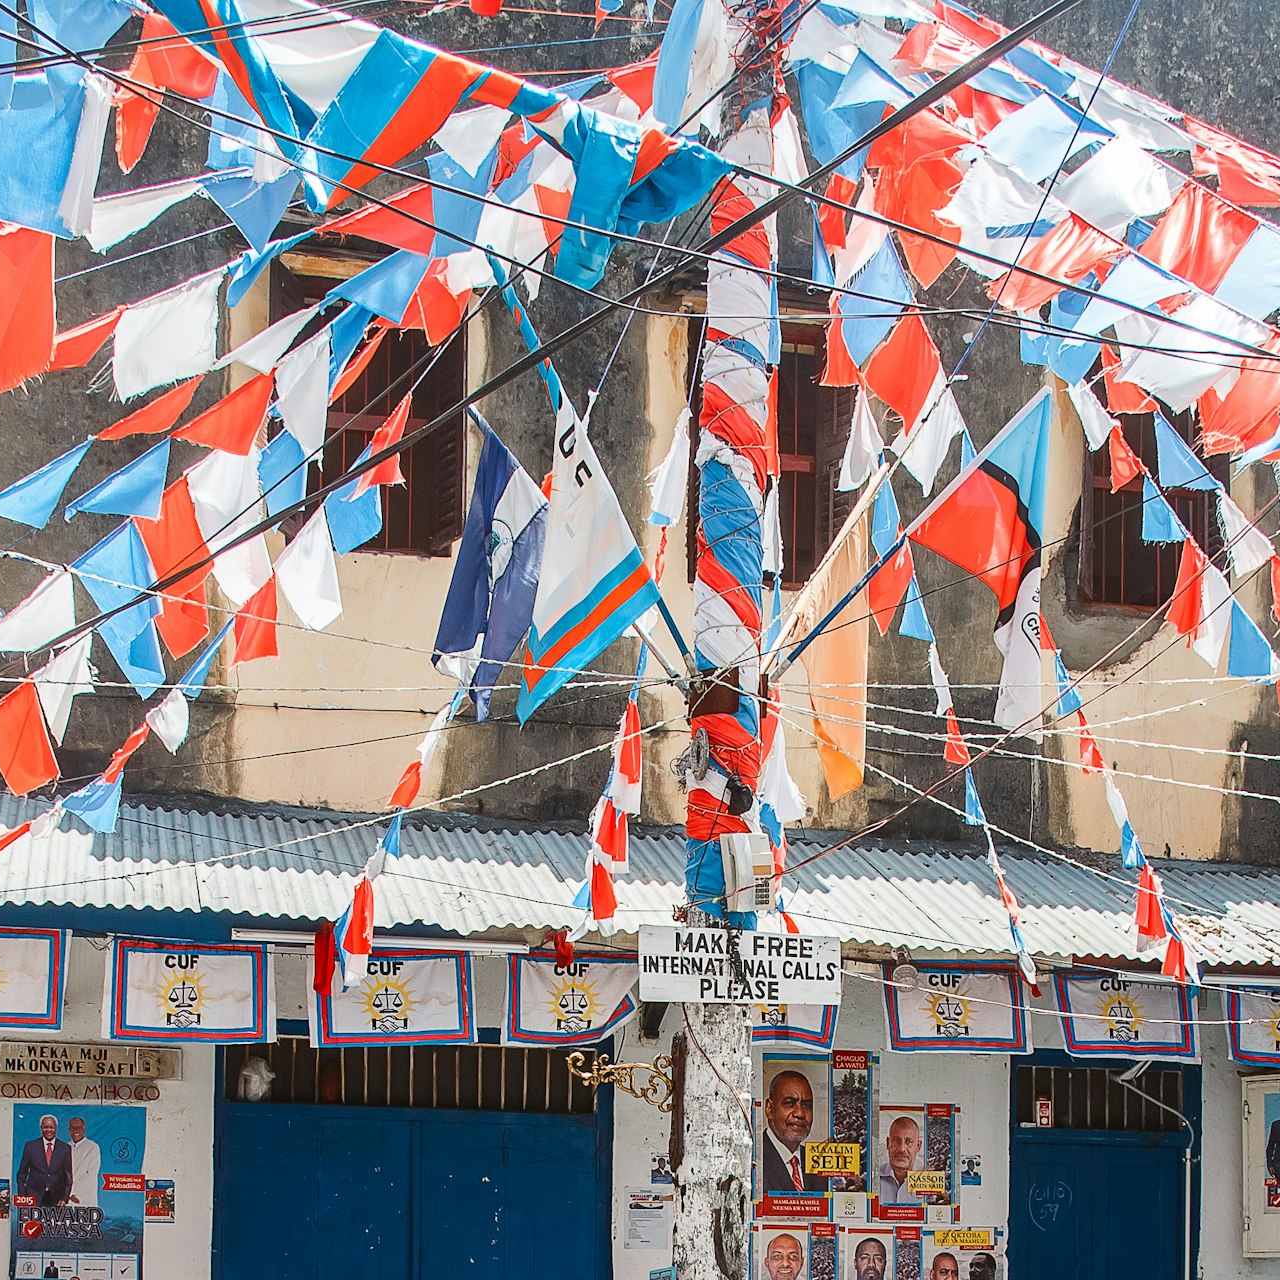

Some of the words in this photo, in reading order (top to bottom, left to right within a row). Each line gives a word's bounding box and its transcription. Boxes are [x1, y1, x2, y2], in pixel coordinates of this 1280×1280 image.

[753, 935, 813, 959] FREE
[164, 954, 200, 970] CUF
[366, 961, 403, 977] CUF
[553, 962, 589, 978] CUF
[782, 960, 837, 982] CALLS
[928, 974, 962, 988] CUF
[1099, 979, 1132, 992] CUF
[700, 978, 779, 1001] PLEASE
[80, 1048, 108, 1061] MJI
[835, 1055, 866, 1063] CHAGUO
[5, 1058, 87, 1073] MKONGWE
[96, 1062, 134, 1076] SAFI
[50, 1083, 74, 1100] YA
[810, 1146, 854, 1154] MAALIM
[810, 1154, 855, 1169] SEIF
[909, 1175, 944, 1183] NASSOR
[18, 1206, 104, 1223] EDWARD
